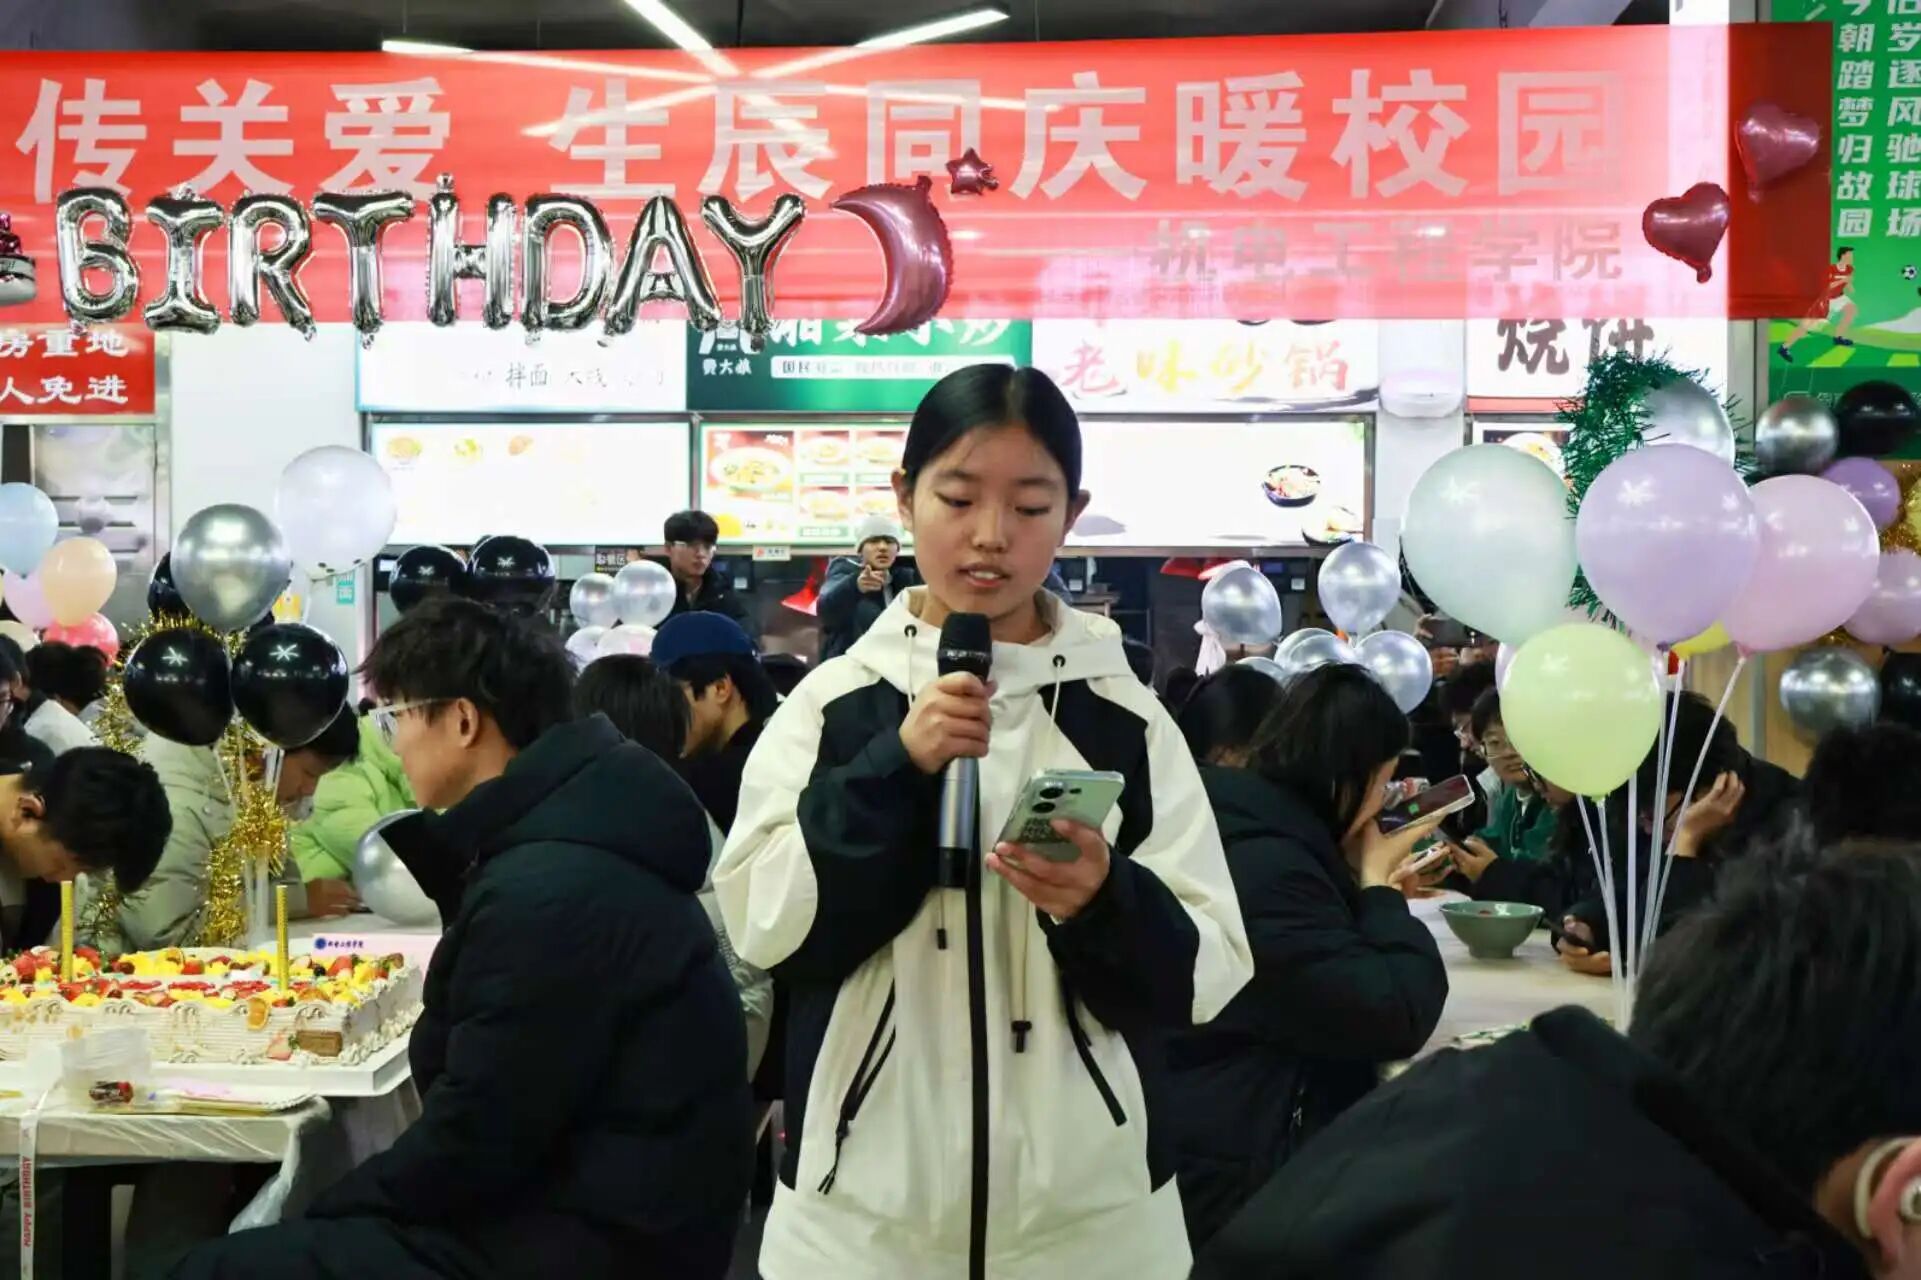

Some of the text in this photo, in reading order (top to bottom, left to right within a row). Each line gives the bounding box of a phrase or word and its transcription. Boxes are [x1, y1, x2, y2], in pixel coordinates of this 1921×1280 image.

[16, 70, 1627, 205] 传关爱 生辰同庆暖校园
[56, 174, 806, 342] BIRTHDAY
